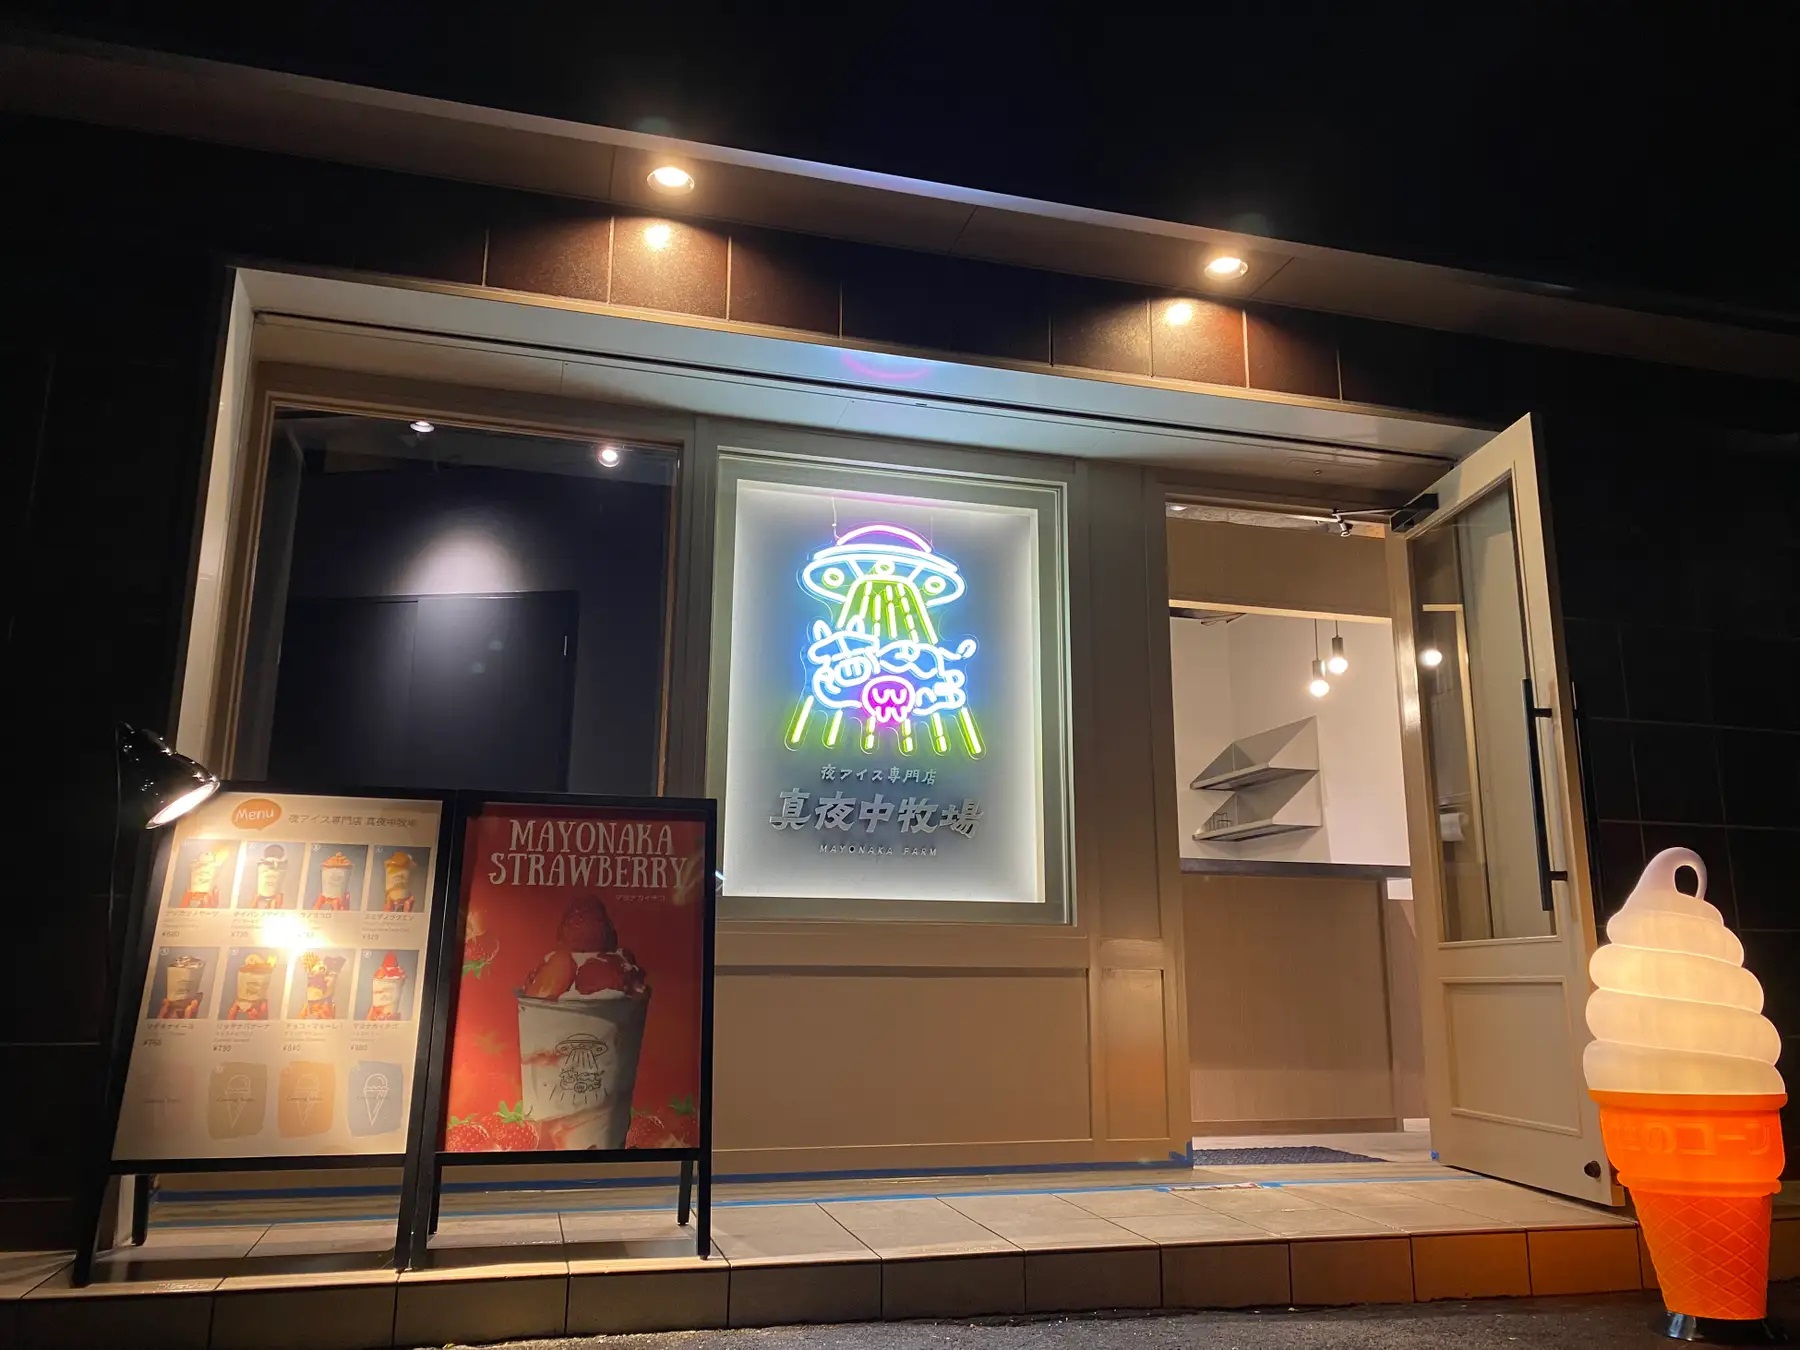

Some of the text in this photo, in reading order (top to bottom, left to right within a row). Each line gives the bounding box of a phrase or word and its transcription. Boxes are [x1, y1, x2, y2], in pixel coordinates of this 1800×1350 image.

[820, 764, 937, 785] 夜アイス専門店
[235, 808, 275, 821] Menu
[288, 814, 362, 826] 夜アイス専門店
[769, 787, 984, 839] 真夜中牧場
[509, 819, 676, 855] MAYONAKA
[818, 844, 938, 857] MAYONAKA FARM
[488, 852, 689, 888] STRAWBERRY
